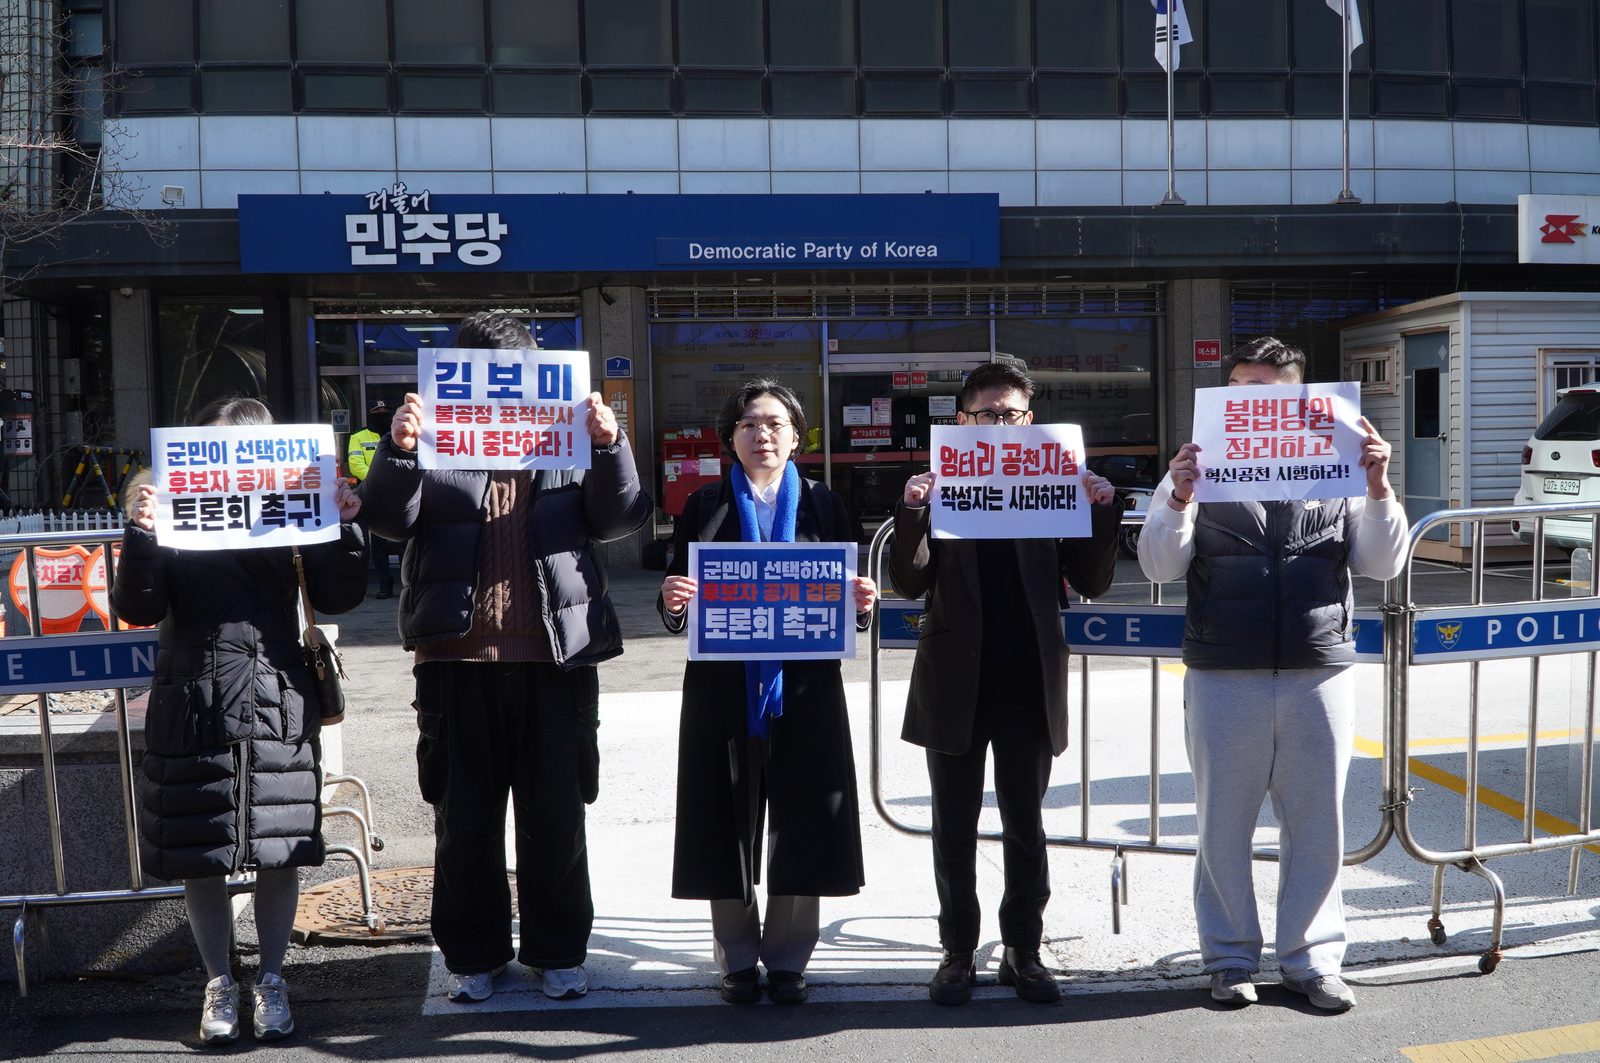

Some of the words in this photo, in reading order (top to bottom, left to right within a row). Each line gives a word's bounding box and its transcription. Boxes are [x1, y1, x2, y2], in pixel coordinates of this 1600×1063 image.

[365, 182, 431, 215] 더불어
[345, 212, 508, 266] 민주당
[688, 241, 796, 260] Democratic
[804, 241, 853, 262] Party
[860, 241, 878, 258] of
[883, 241, 939, 258] Korea
[615, 359, 621, 369] 7
[435, 404, 492, 425] 불공정
[499, 405, 574, 426] 표적심사
[1224, 397, 1335, 433] 불법당원
[166, 440, 228, 467] 군민이
[235, 438, 321, 464] 선택하자!
[435, 430, 475, 457] 즉시
[1226, 434, 1333, 460] 정리하고
[940, 440, 995, 477] 엉터리
[1001, 442, 1079, 477] 공천지침
[168, 469, 231, 495] 후보자
[236, 467, 276, 493] 공개
[283, 466, 322, 491] 검증
[1205, 466, 1270, 483] 혁신공천
[1276, 464, 1350, 481] 시행하라!
[940, 486, 1003, 511] 작성자는
[1009, 484, 1077, 511] 사과하라!
[172, 495, 251, 532] 토론회
[261, 493, 322, 528] 촉구!
[36, 564, 84, 584] 차금지
[703, 560, 758, 580] 군민이
[763, 560, 843, 580] 선택하자!
[702, 583, 759, 603] 후보자
[763, 583, 800, 603] 공개
[805, 583, 842, 603] 검증
[704, 606, 775, 640] 토론회
[782, 606, 837, 640] 촉구!
[1487, 613, 1600, 646] POLI
[70, 645, 157, 678] LIN
